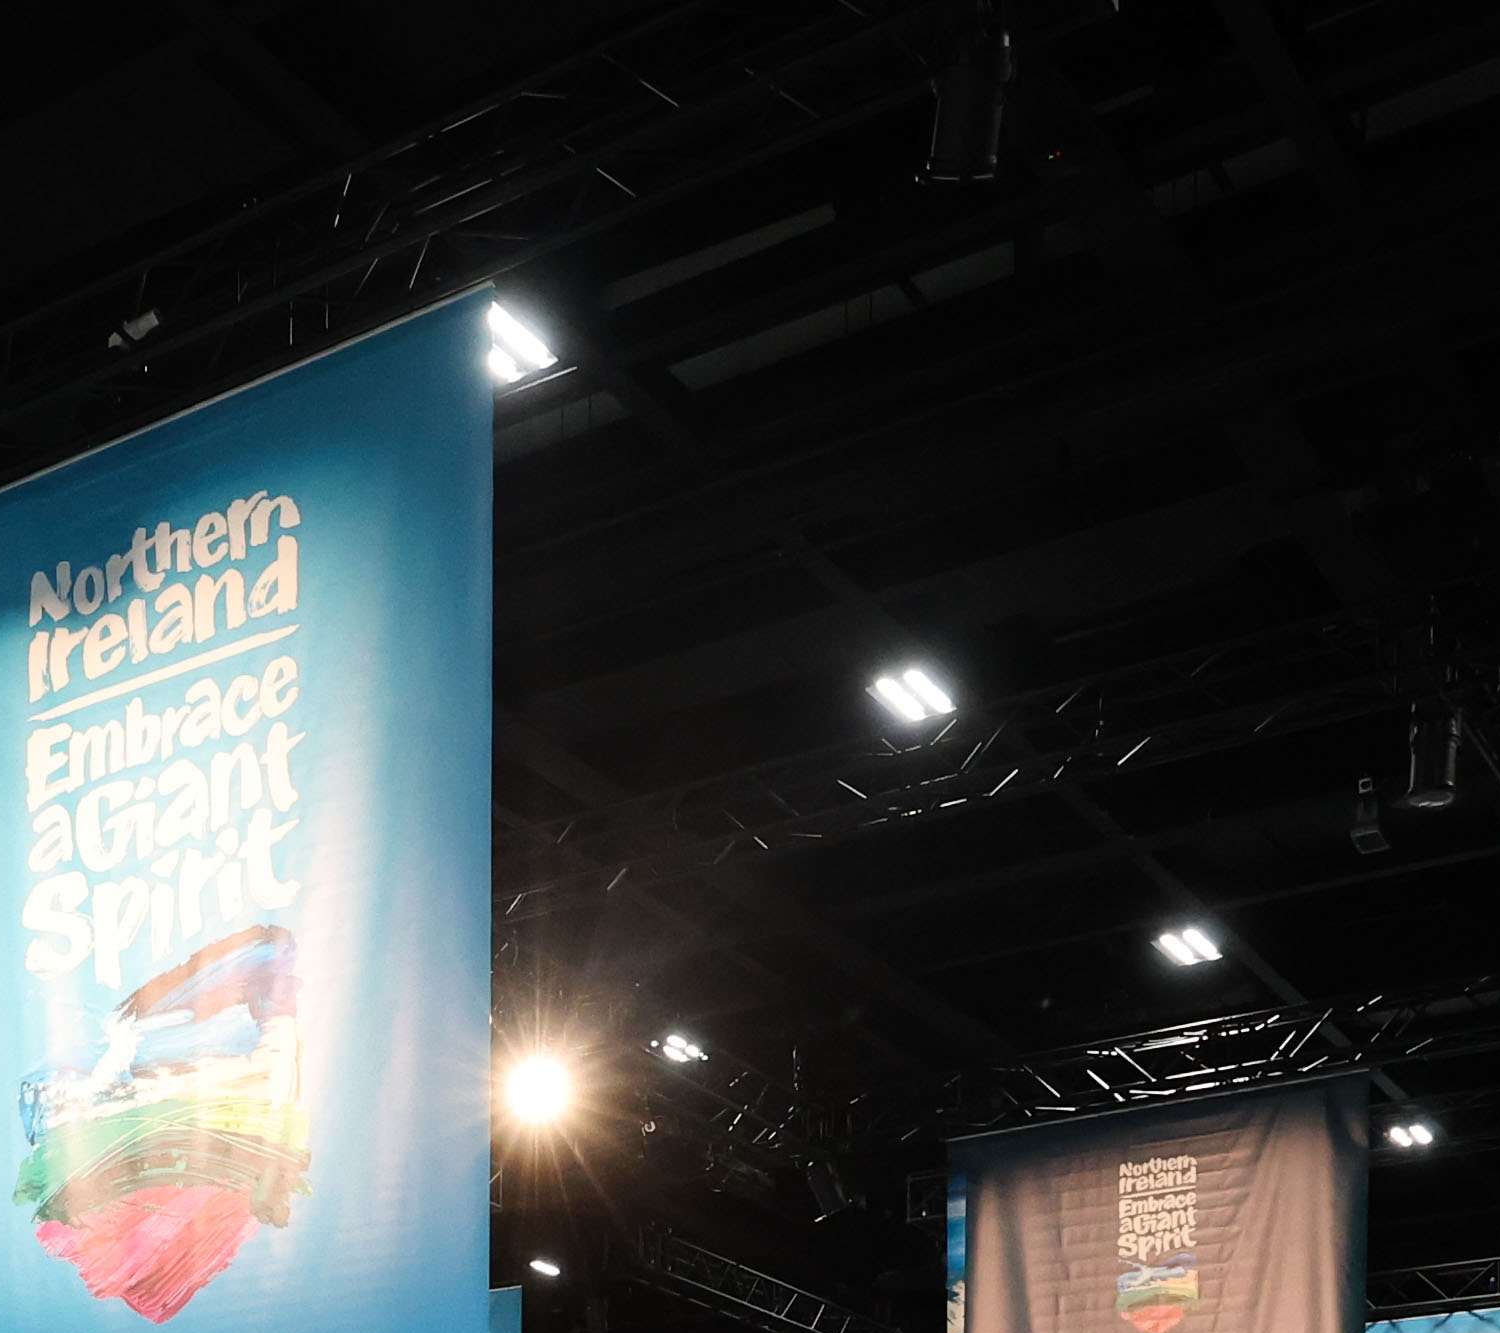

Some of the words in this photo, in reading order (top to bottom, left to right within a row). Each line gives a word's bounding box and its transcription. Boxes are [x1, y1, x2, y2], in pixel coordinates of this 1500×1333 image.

[30, 490, 301, 628] Northern
[29, 536, 301, 703] Ireland
[27, 654, 301, 812] Embrace
[23, 812, 303, 990] Spirit
[1118, 1191, 1196, 1218] Embrace
[1119, 1154, 1198, 1177] Northern
[1119, 1166, 1196, 1194] Ireland
[1117, 1226, 1198, 1261] Spirit
